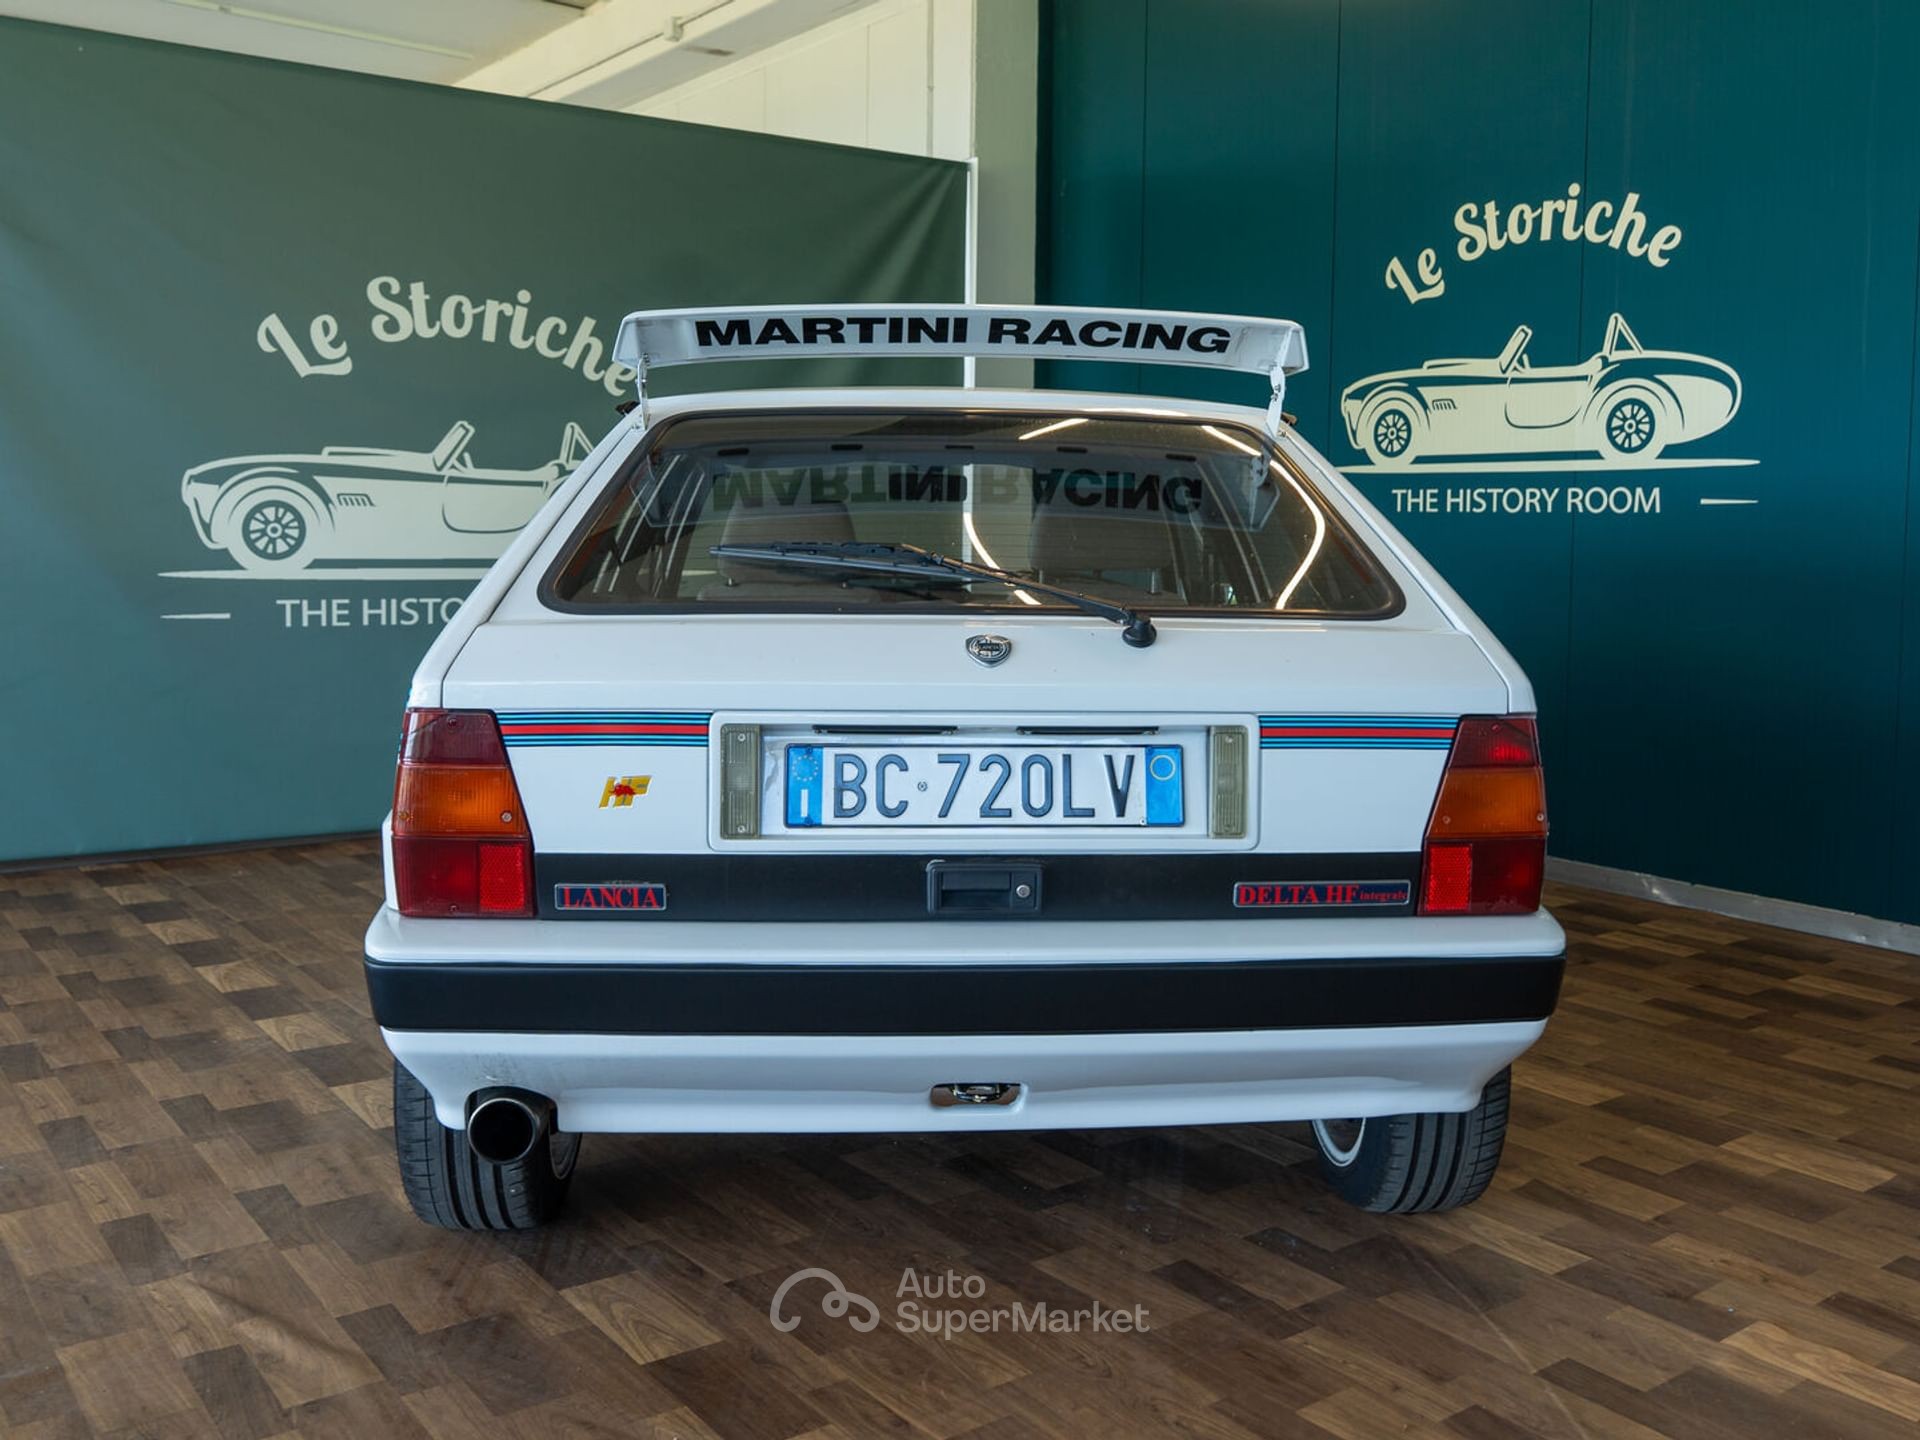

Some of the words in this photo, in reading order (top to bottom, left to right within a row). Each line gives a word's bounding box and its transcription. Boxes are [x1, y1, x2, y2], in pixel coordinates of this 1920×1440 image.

[1385, 247, 1446, 304] Le
[1453, 182, 1682, 267] Storiche
[256, 312, 353, 378] Le
[366, 275, 637, 396] Storiche
[695, 317, 968, 347] MARTINI
[988, 317, 1232, 353] RACING
[1392, 488, 1438, 513] THE
[1446, 487, 1560, 513] HISTORY
[1567, 487, 1661, 513] ROOM
[276, 599, 351, 628] THE
[598, 775, 652, 809] HF
[563, 886, 660, 909] LANCIA
[1238, 884, 1319, 905] DELTA
[1326, 884, 1359, 904] HF
